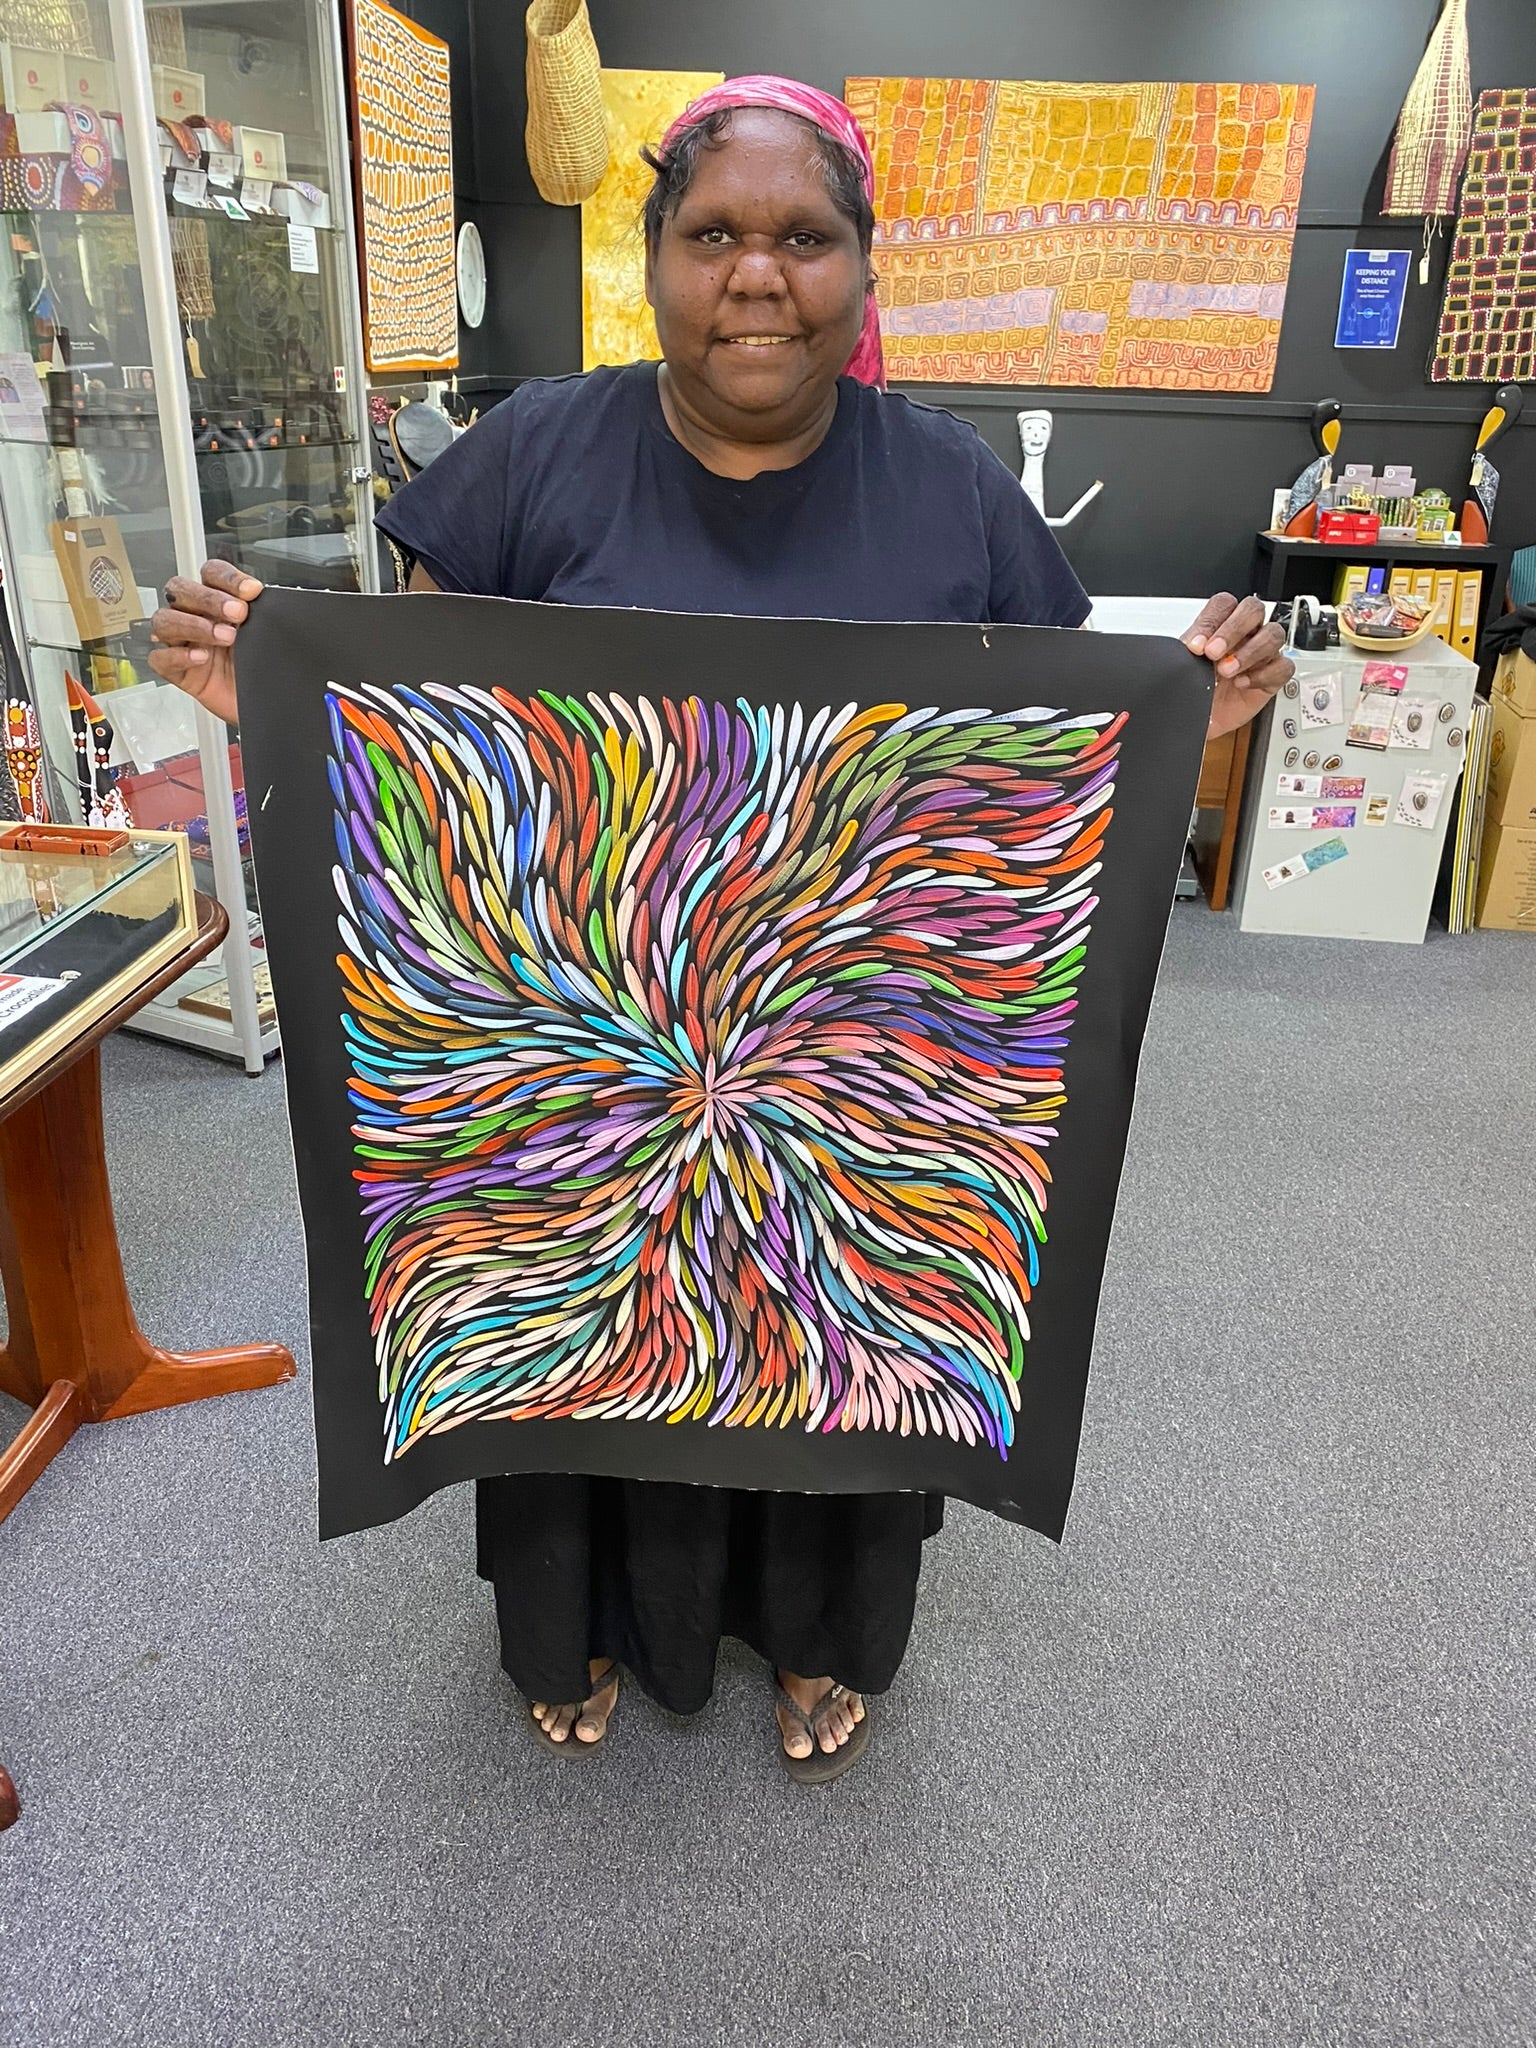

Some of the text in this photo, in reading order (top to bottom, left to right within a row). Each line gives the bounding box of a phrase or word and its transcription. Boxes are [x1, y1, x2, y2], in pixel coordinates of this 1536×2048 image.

[1355, 268, 1396, 277] KEEPING YOUR
[1361, 277, 1389, 285] DISTANCE
